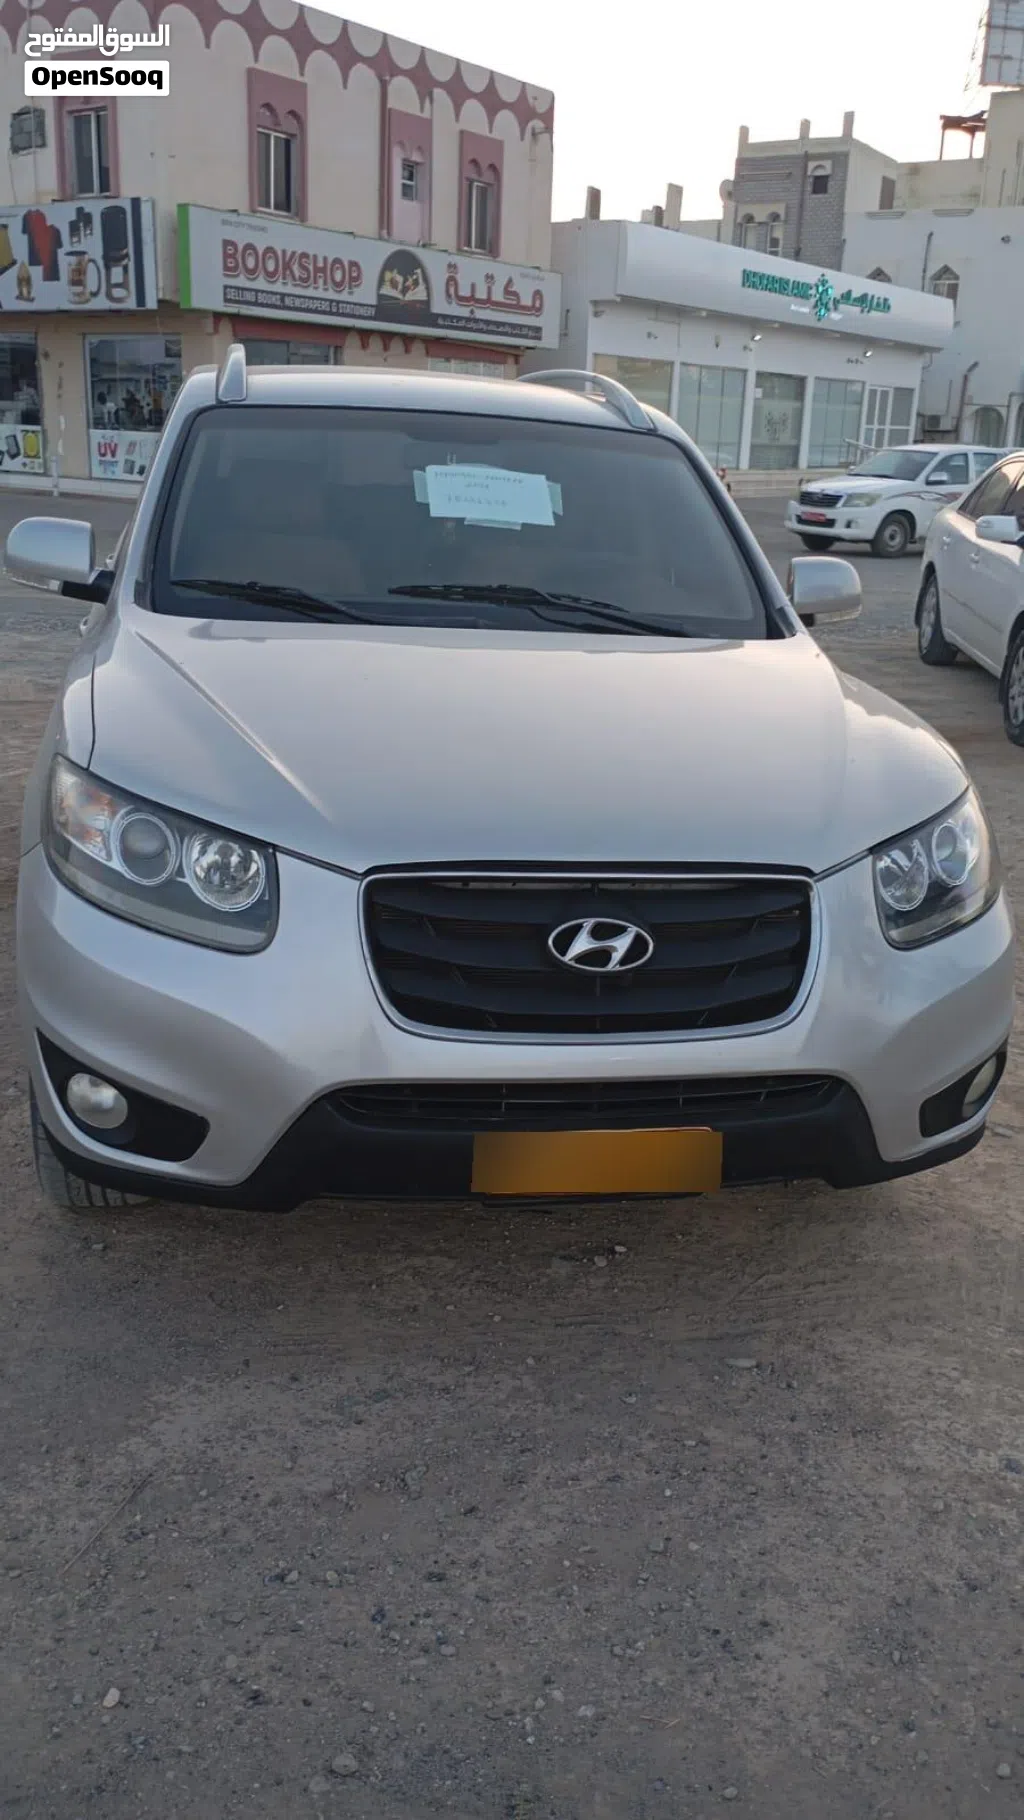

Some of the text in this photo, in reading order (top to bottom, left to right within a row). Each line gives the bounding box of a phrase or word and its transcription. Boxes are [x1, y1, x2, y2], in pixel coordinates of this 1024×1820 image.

[222, 238, 363, 293] BOOKSHOP
[226, 288, 256, 302] SELLING
[284, 295, 331, 311] NEWSPAPERS
[338, 302, 376, 317] STATIONERY
[446, 262, 543, 318] مكتبة
[98, 441, 118, 458] UV
